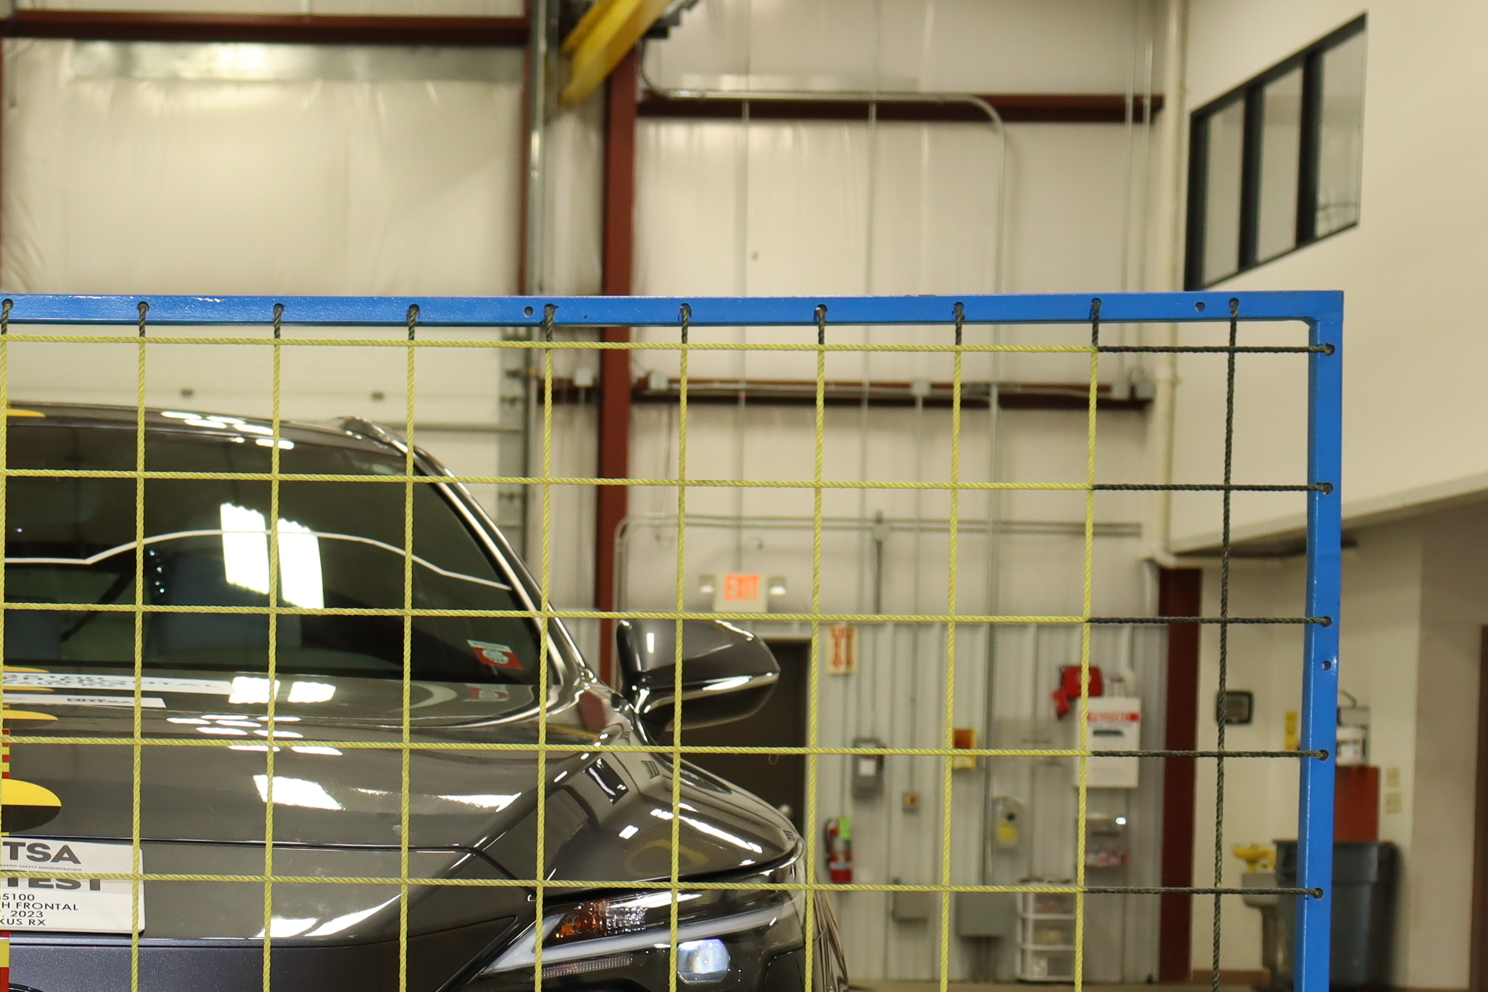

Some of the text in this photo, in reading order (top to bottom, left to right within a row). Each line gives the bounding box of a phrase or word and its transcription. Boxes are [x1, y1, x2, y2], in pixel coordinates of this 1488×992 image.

[725, 574, 761, 601] EXIT
[16, 902, 79, 911] FRONTAL
[10, 910, 44, 918] 2023
[28, 918, 46, 926] RX
